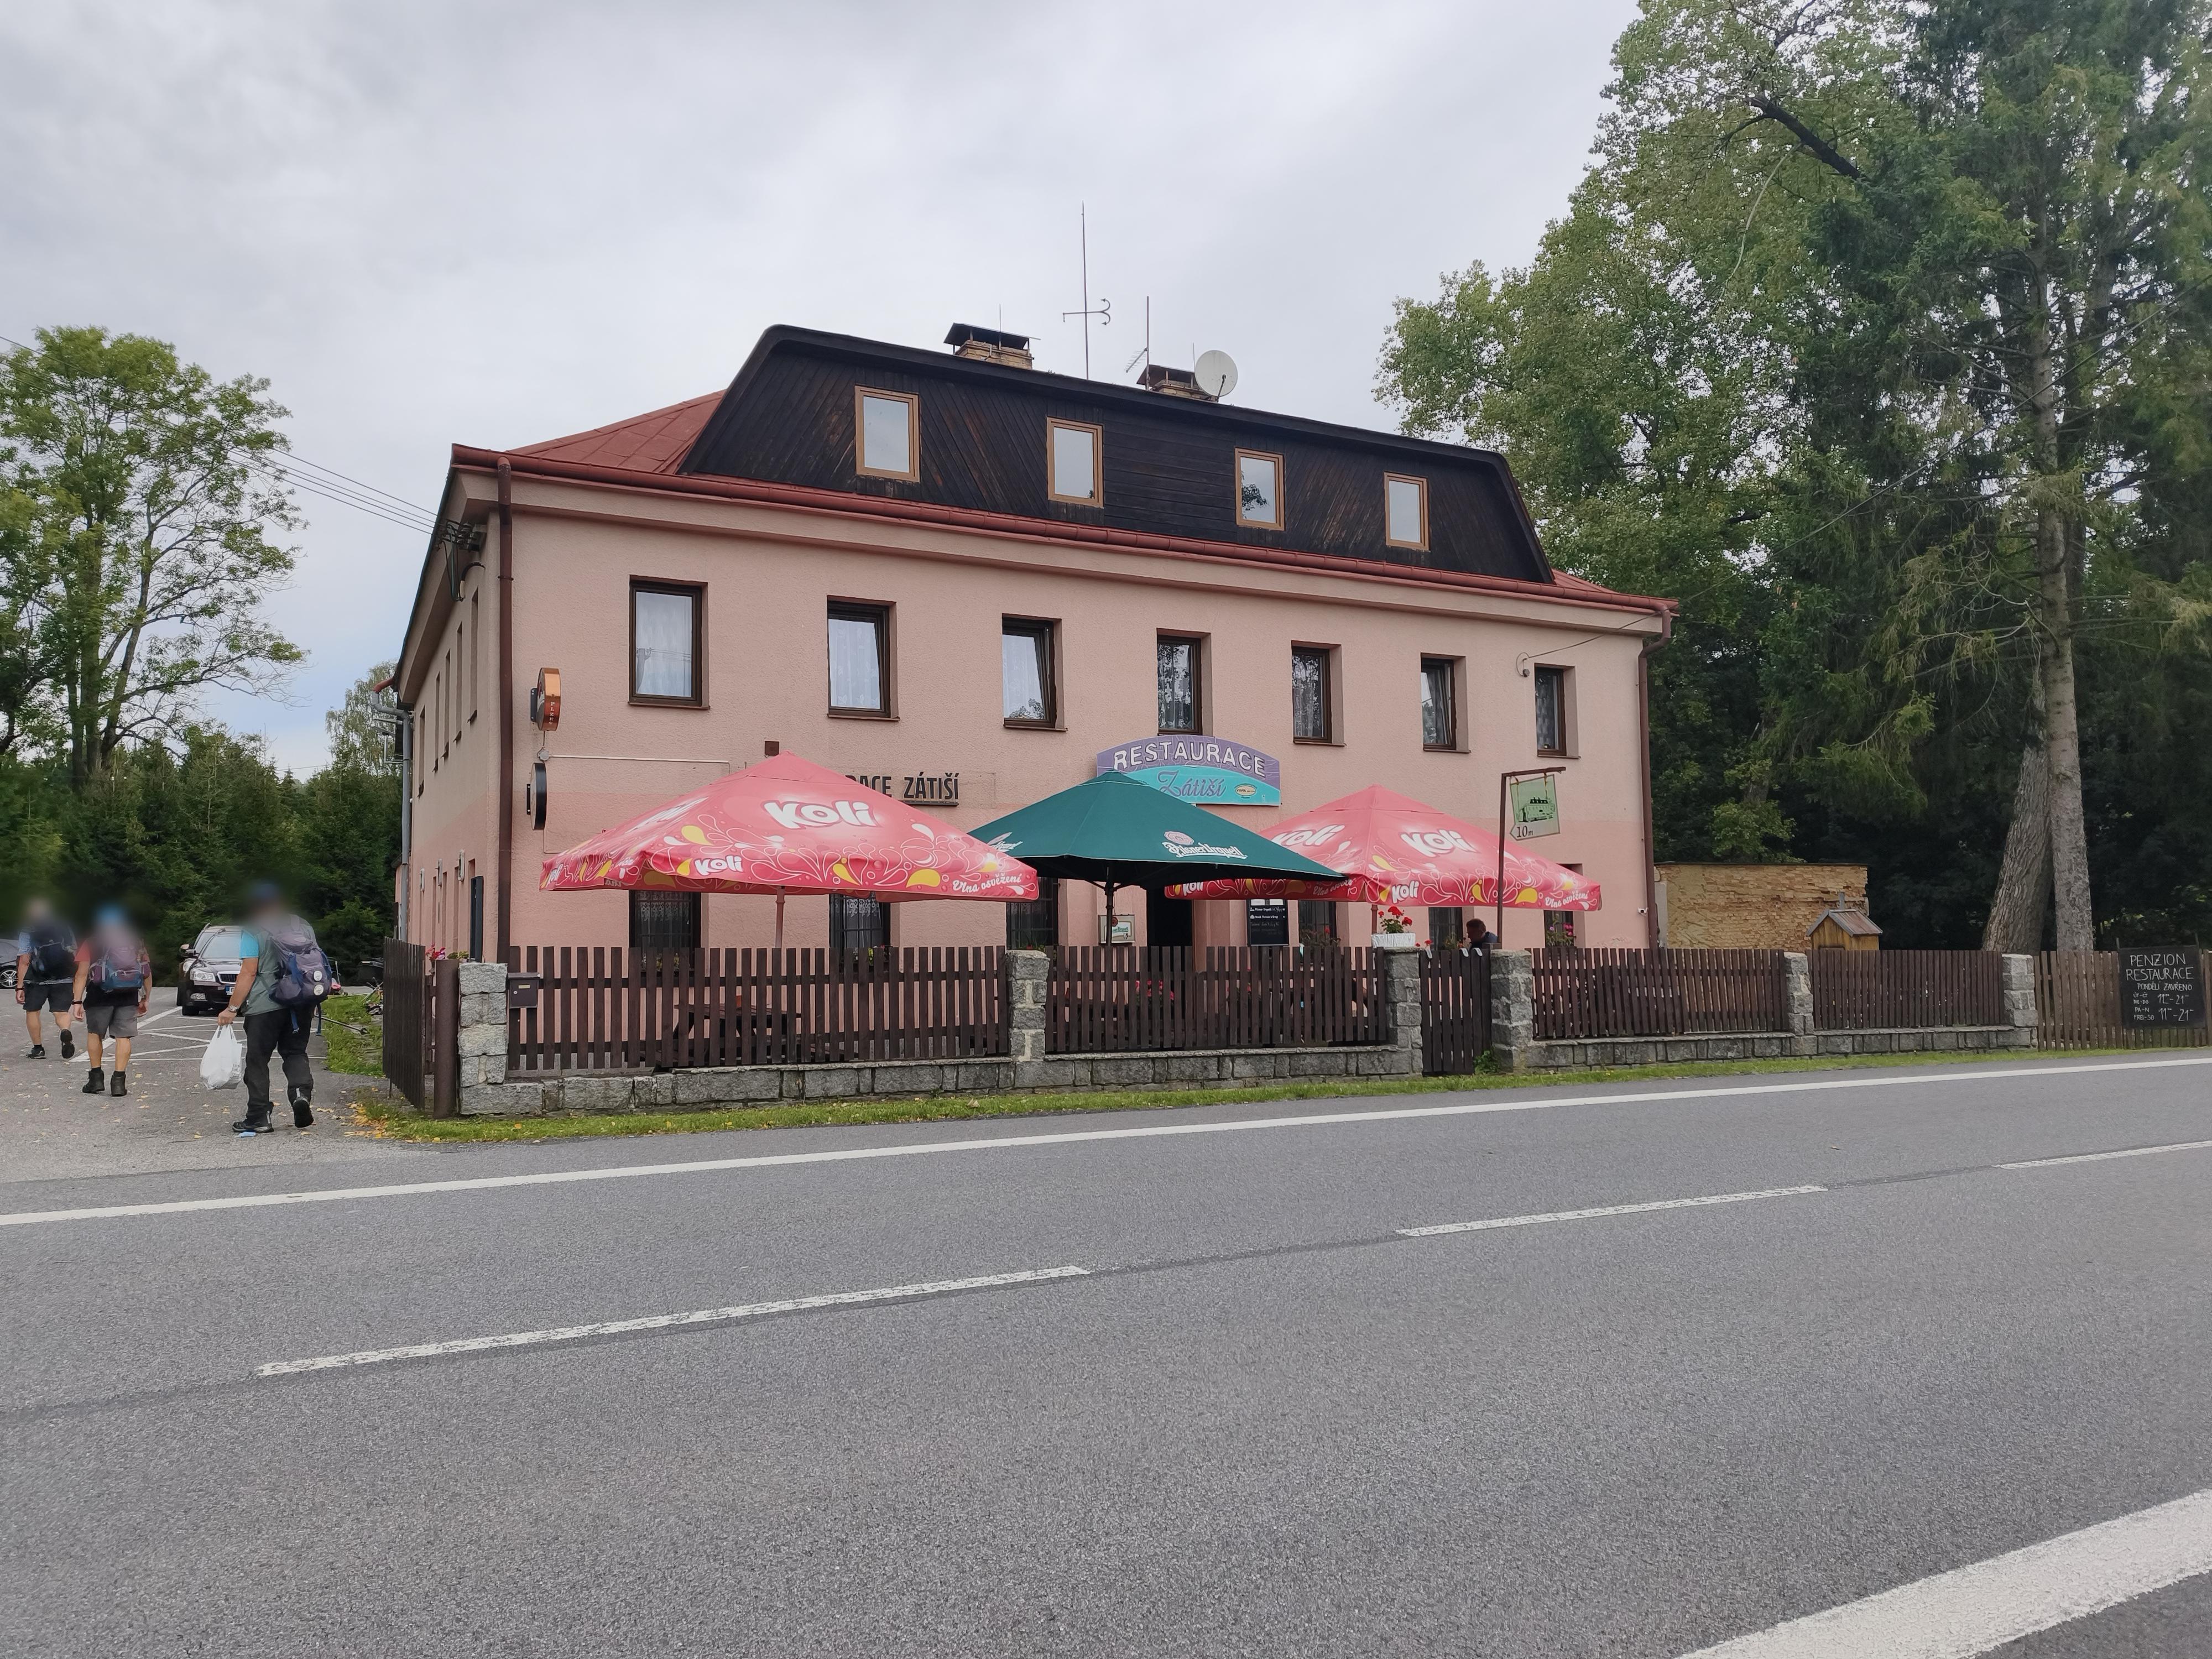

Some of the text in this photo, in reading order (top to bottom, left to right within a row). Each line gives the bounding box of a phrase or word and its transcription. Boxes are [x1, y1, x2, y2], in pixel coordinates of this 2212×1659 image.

[1113, 741, 1266, 778] RESTAURACE
[904, 771, 959, 800] ZÁTIŠÍ
[1157, 769, 1227, 797] Zátiší
[763, 800, 878, 830] Koli
[1162, 842, 1248, 859] Pilsner Urquell
[1400, 829, 1479, 858] Koli
[695, 855, 743, 876] Koli
[1391, 880, 1420, 904] Koli
[2130, 953, 2186, 967] PENZION
[2126, 967, 2194, 982] RESTAURACE
